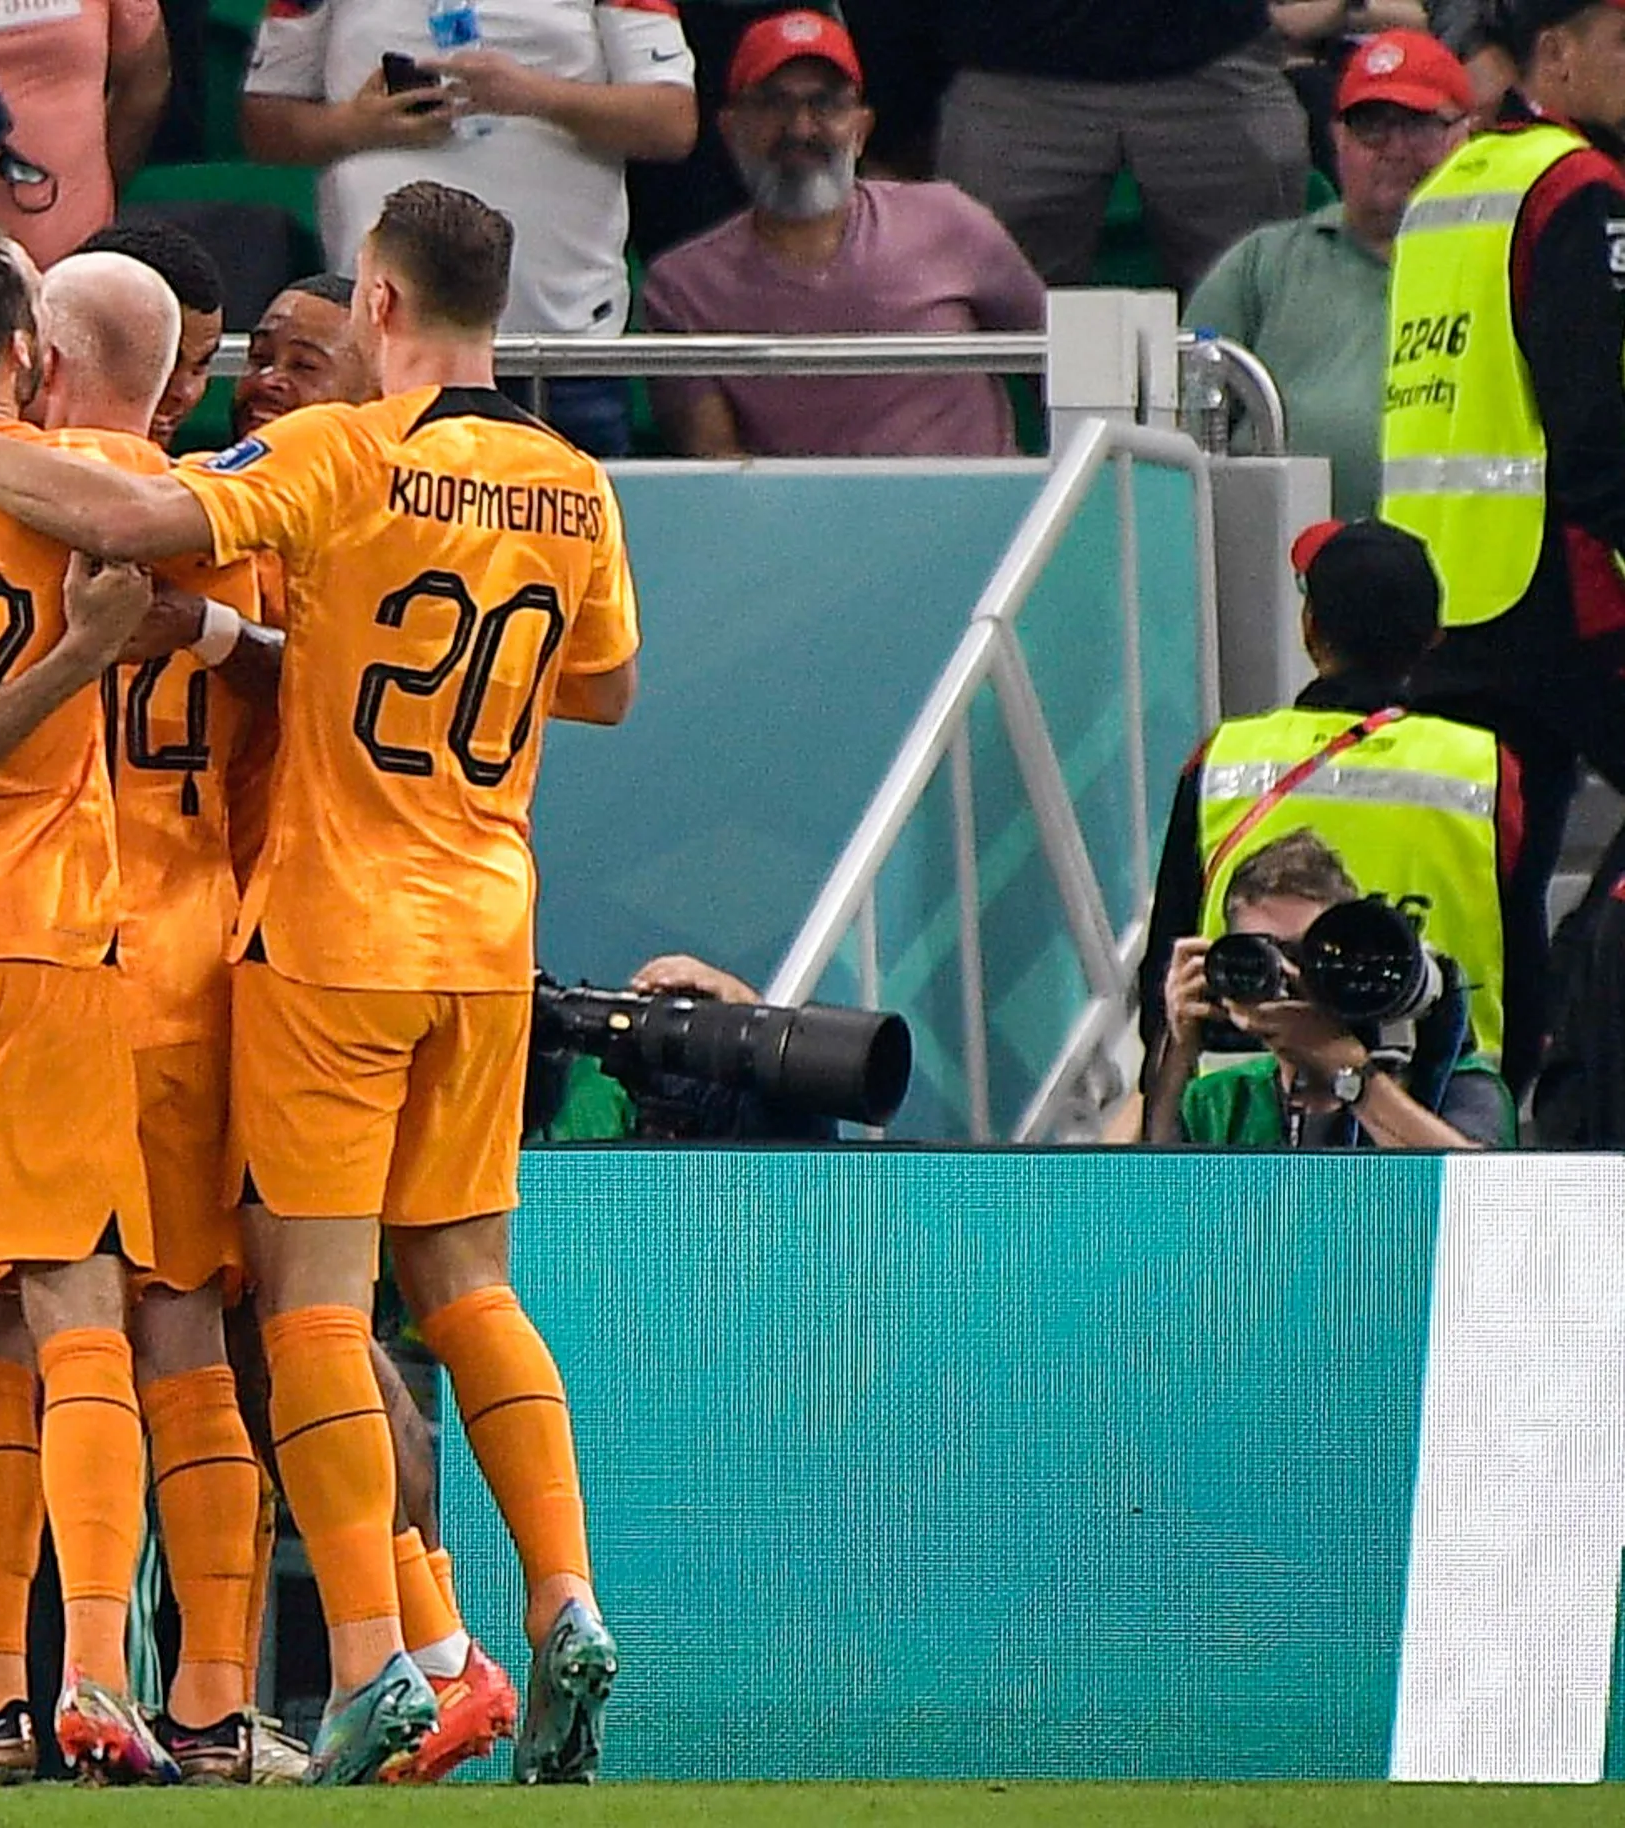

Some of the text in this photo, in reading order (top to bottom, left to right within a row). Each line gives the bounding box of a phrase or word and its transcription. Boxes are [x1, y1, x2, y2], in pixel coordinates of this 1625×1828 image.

[1393, 312, 1470, 366] 2246
[389, 466, 602, 542] KOOPMEINERS
[353, 569, 565, 787] 20
